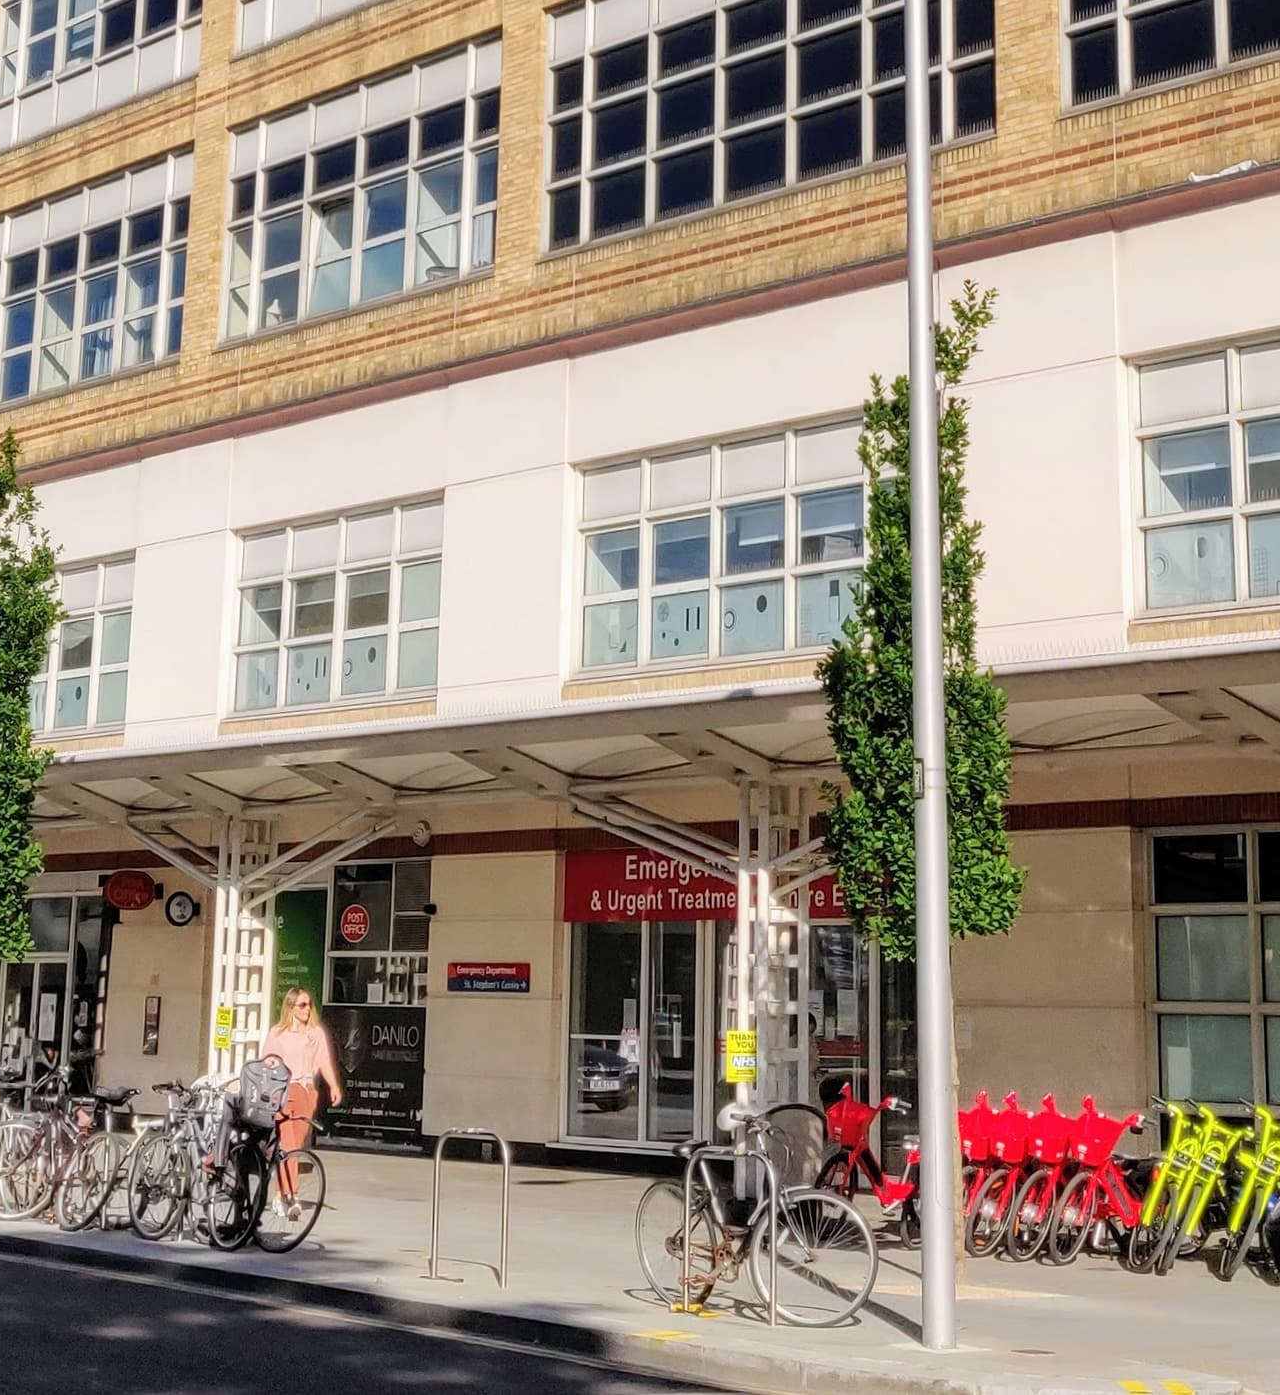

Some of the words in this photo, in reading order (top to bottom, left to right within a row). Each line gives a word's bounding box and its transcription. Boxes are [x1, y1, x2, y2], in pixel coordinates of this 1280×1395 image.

[590, 890, 602, 911] &
[608, 889, 662, 916] Urgent
[668, 888, 737, 910] Treatme
[347, 913, 364, 923] POST
[343, 924, 366, 934] OFFICE
[457, 966, 485, 976] Emergency
[486, 966, 516, 976] Department
[372, 1025, 420, 1047] DANILO
[736, 1040, 754, 1048] YOU
